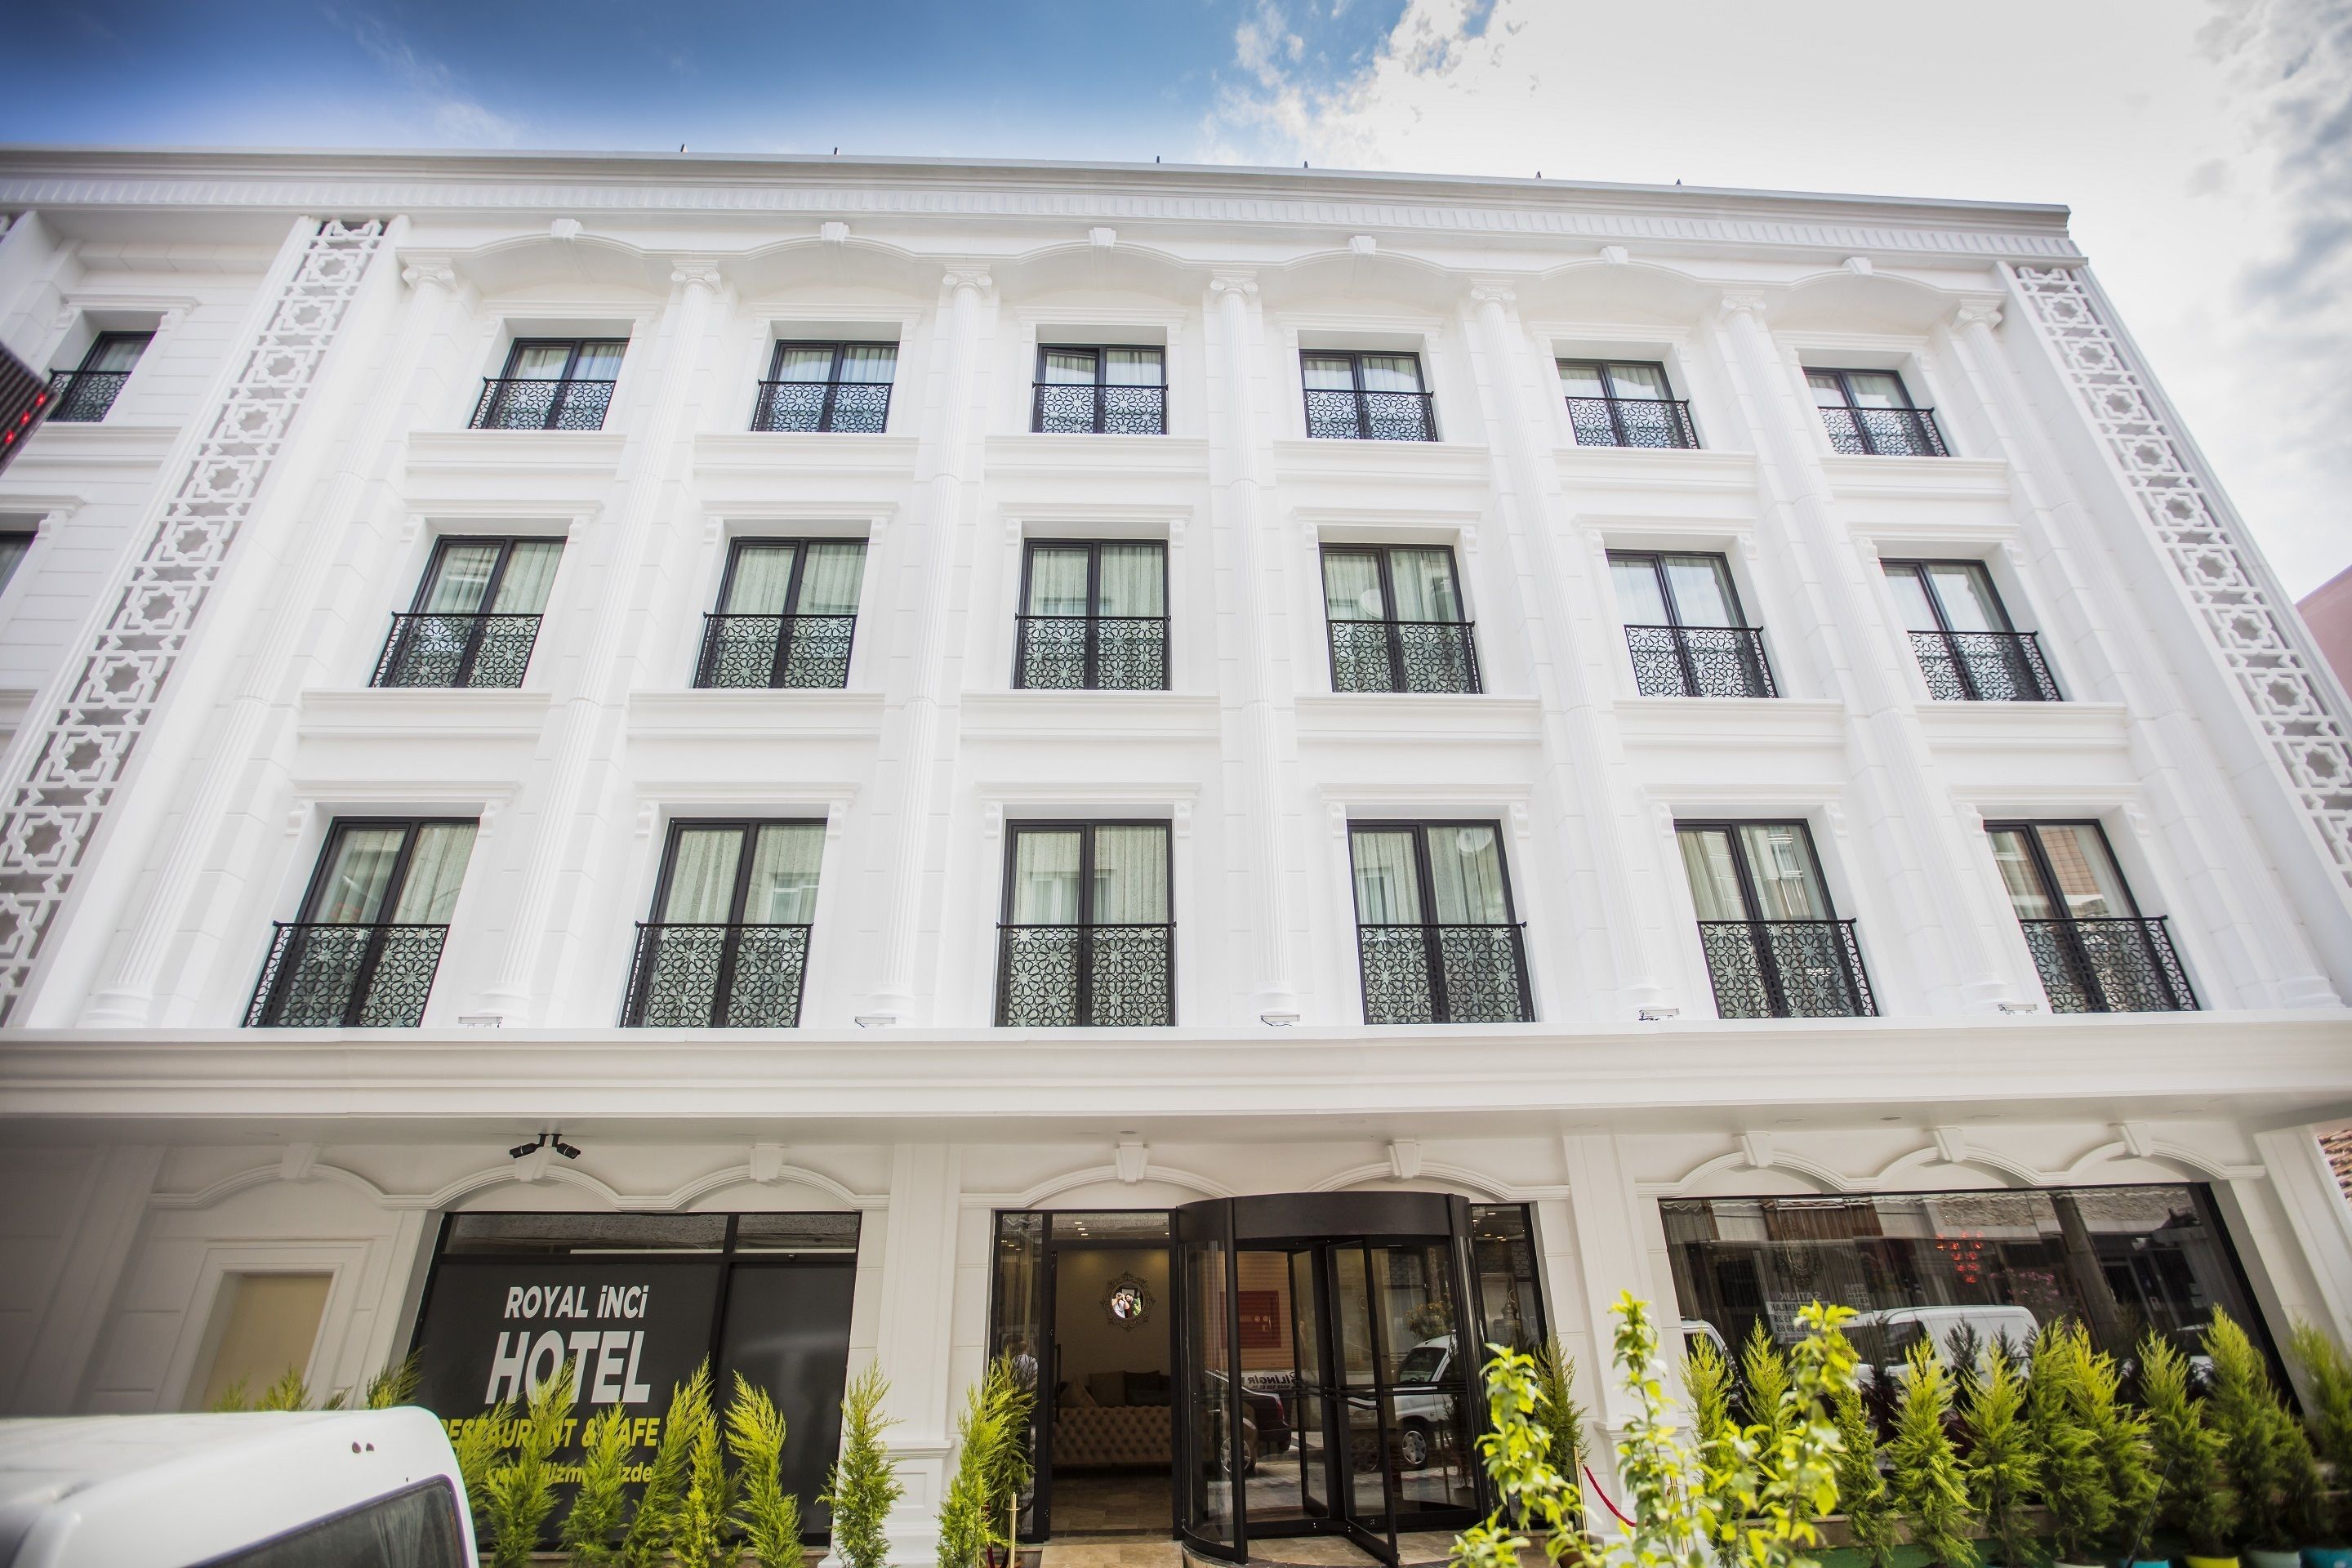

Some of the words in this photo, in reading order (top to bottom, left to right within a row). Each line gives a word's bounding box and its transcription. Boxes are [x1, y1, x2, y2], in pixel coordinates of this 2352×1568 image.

[504, 1285, 589, 1319] ROYAL
[484, 1330, 651, 1404] HOTEL
[604, 1418, 661, 1447] AFE
